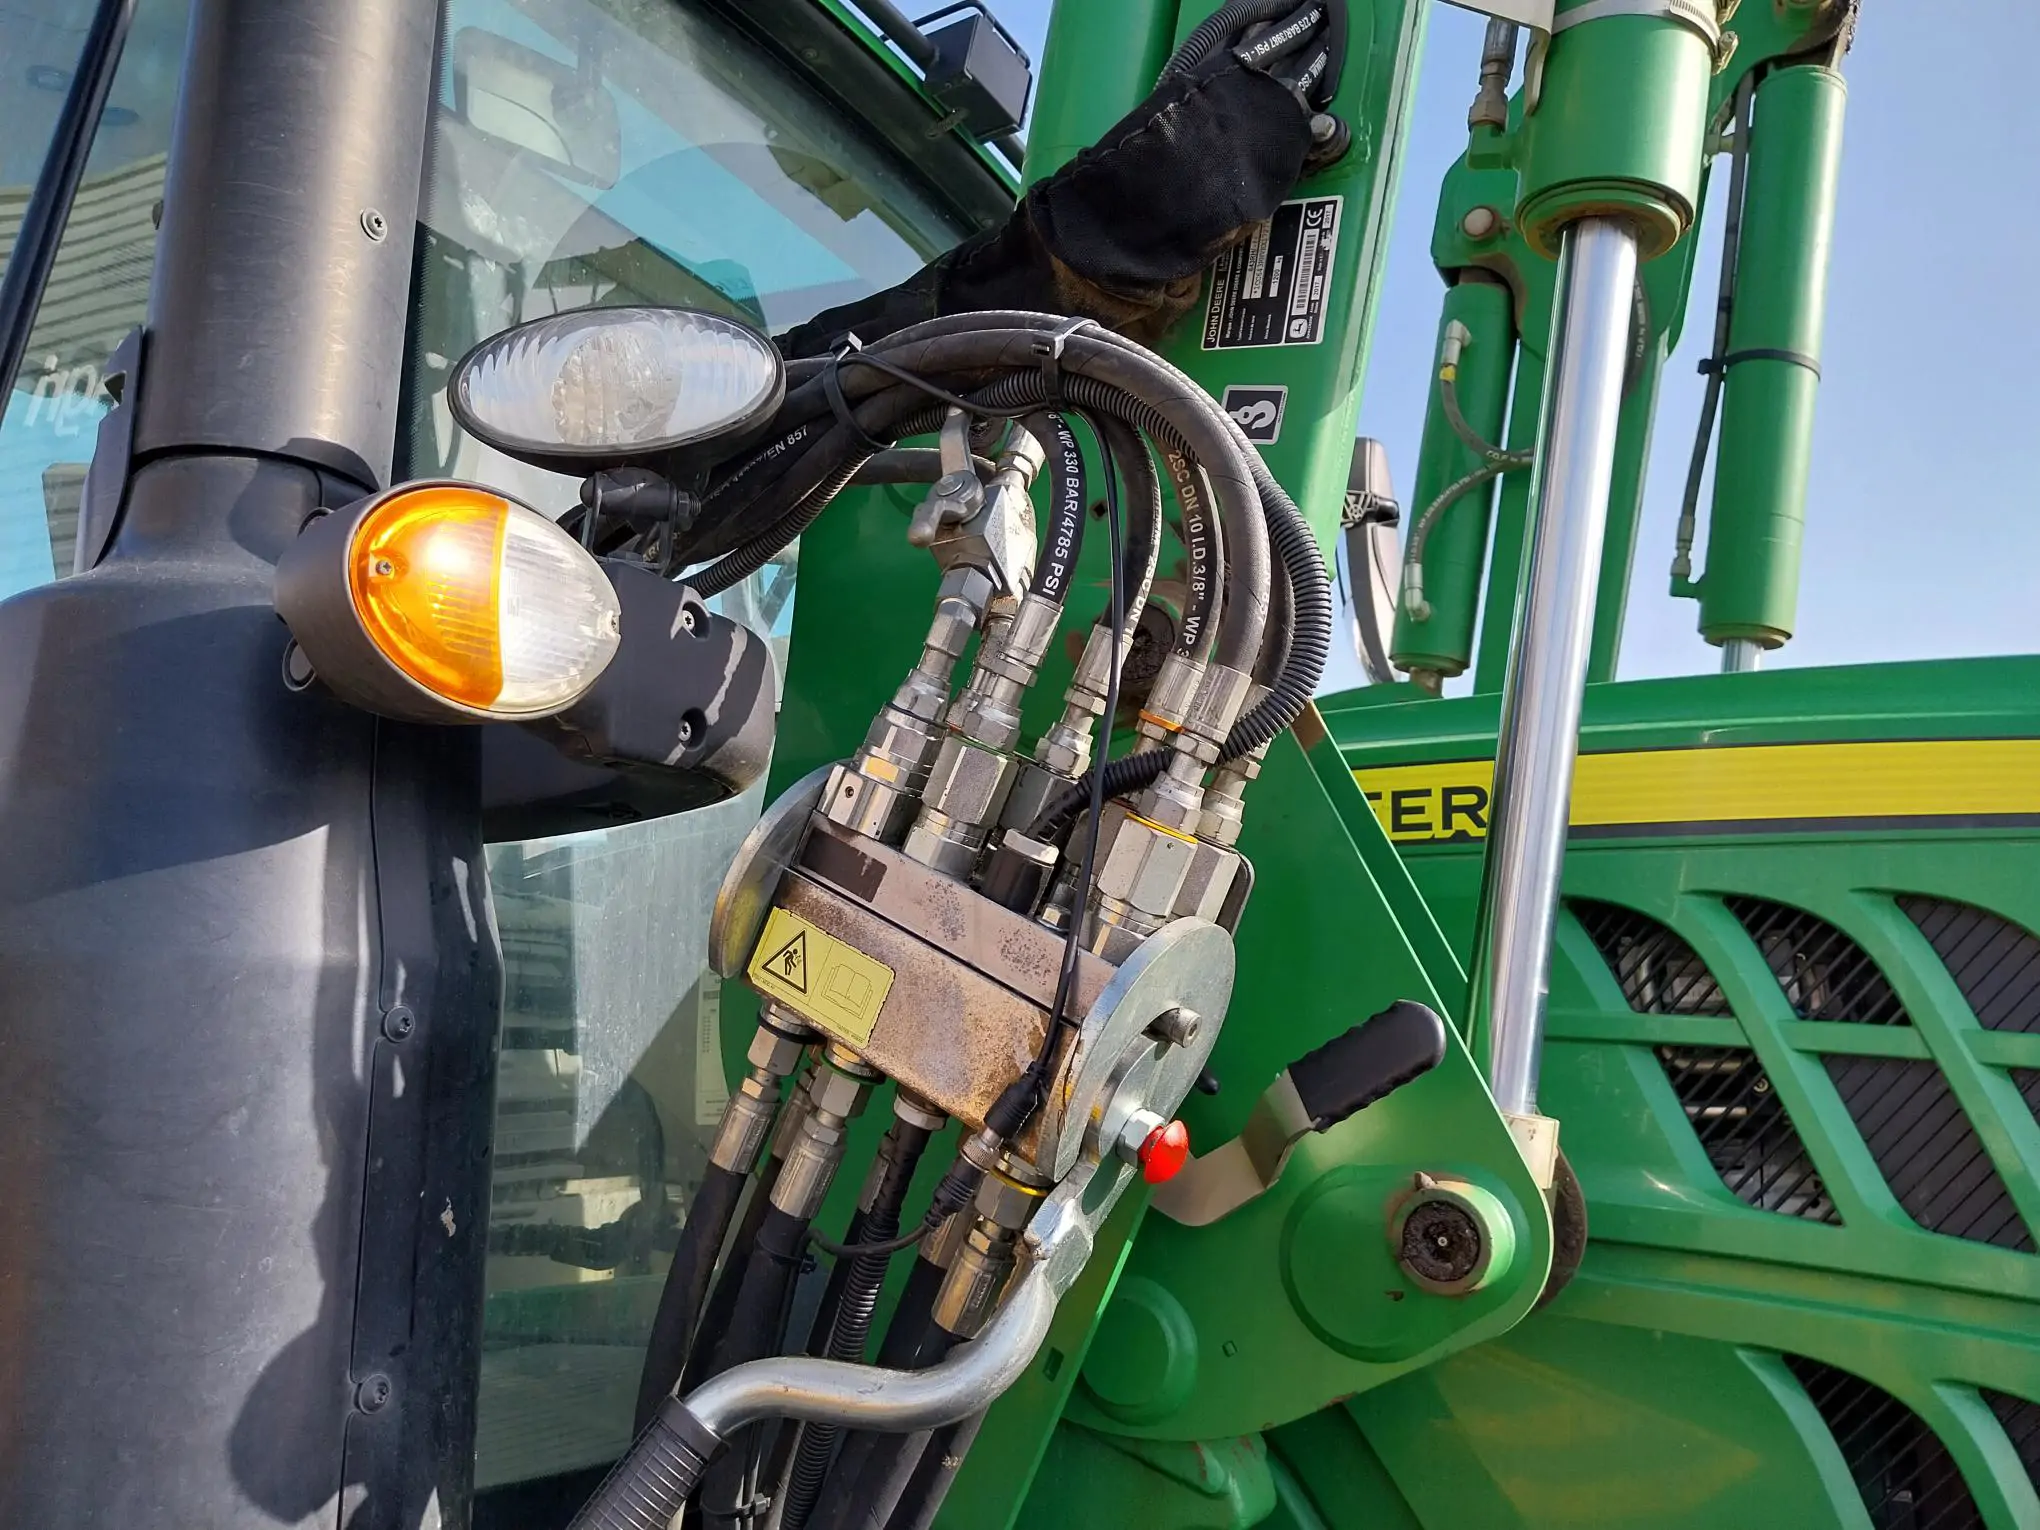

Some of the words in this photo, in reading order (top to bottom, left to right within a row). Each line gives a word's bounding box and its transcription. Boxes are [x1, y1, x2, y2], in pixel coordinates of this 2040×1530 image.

[1299, 18, 1311, 31] 275
[1254, 42, 1271, 55] PSI
[1297, 75, 1312, 92] 2SC
[1272, 268, 1280, 284] 1200
[1211, 279, 1225, 312] DEERE
[1206, 315, 1219, 342] JOHN
[787, 425, 809, 446] 857
[1057, 429, 1075, 448] WP
[1063, 450, 1079, 473] 330
[1168, 449, 1190, 484] 2SC
[1181, 484, 1199, 512] DN
[1057, 477, 1080, 560] BAR/4785
[1188, 515, 1203, 532] 10
[1043, 563, 1065, 596] PSI
[1128, 599, 1145, 625] DN
[1183, 616, 1201, 644] WP
[1365, 786, 1488, 832] ER
